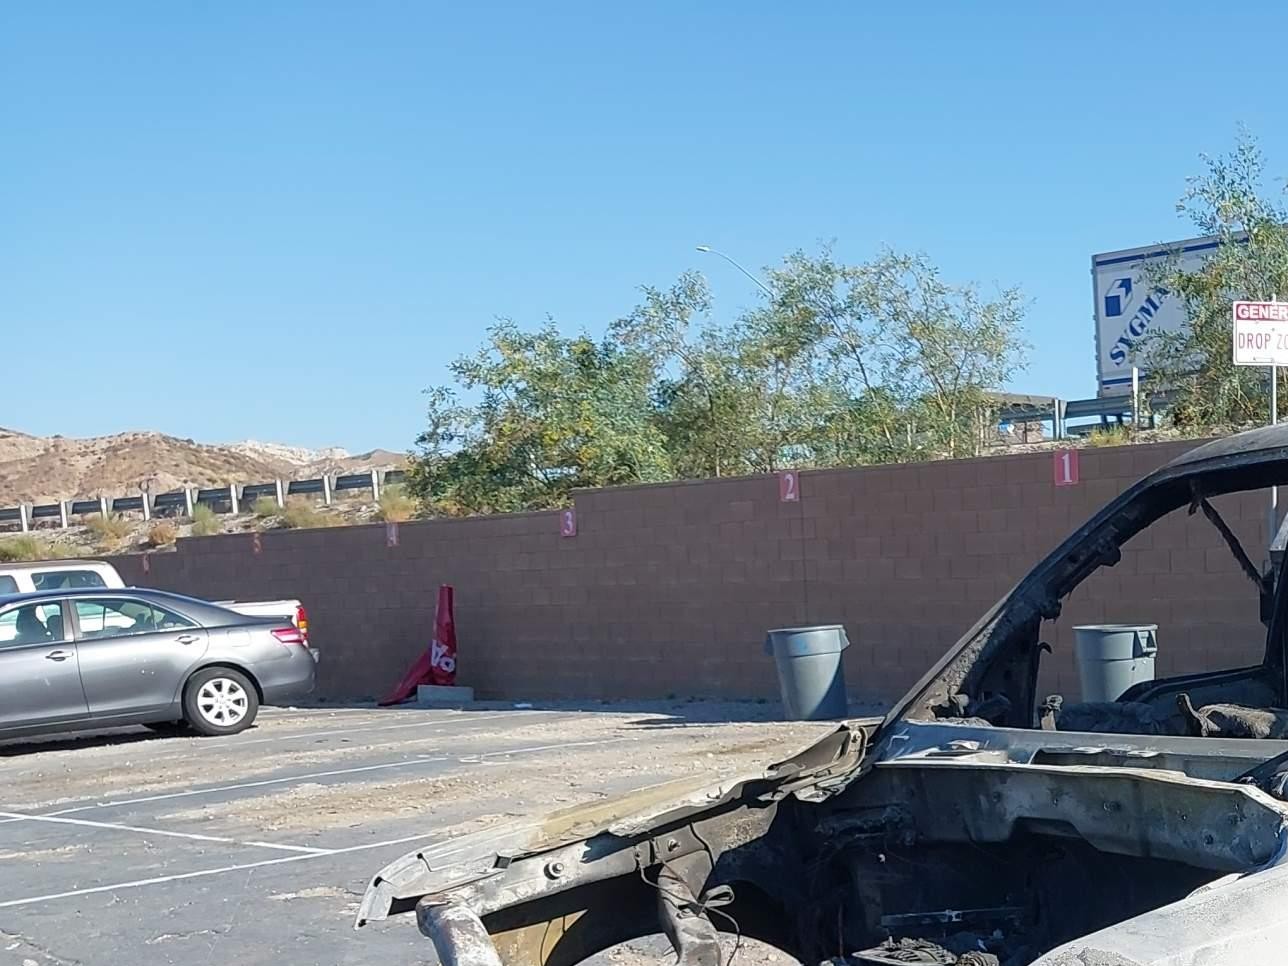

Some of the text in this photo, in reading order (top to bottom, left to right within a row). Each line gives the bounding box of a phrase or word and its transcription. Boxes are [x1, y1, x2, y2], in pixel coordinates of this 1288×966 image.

[1238, 333, 1270, 349] DROP
[1062, 453, 1072, 482] 1
[784, 473, 795, 499] 2
[563, 511, 574, 534] 3
